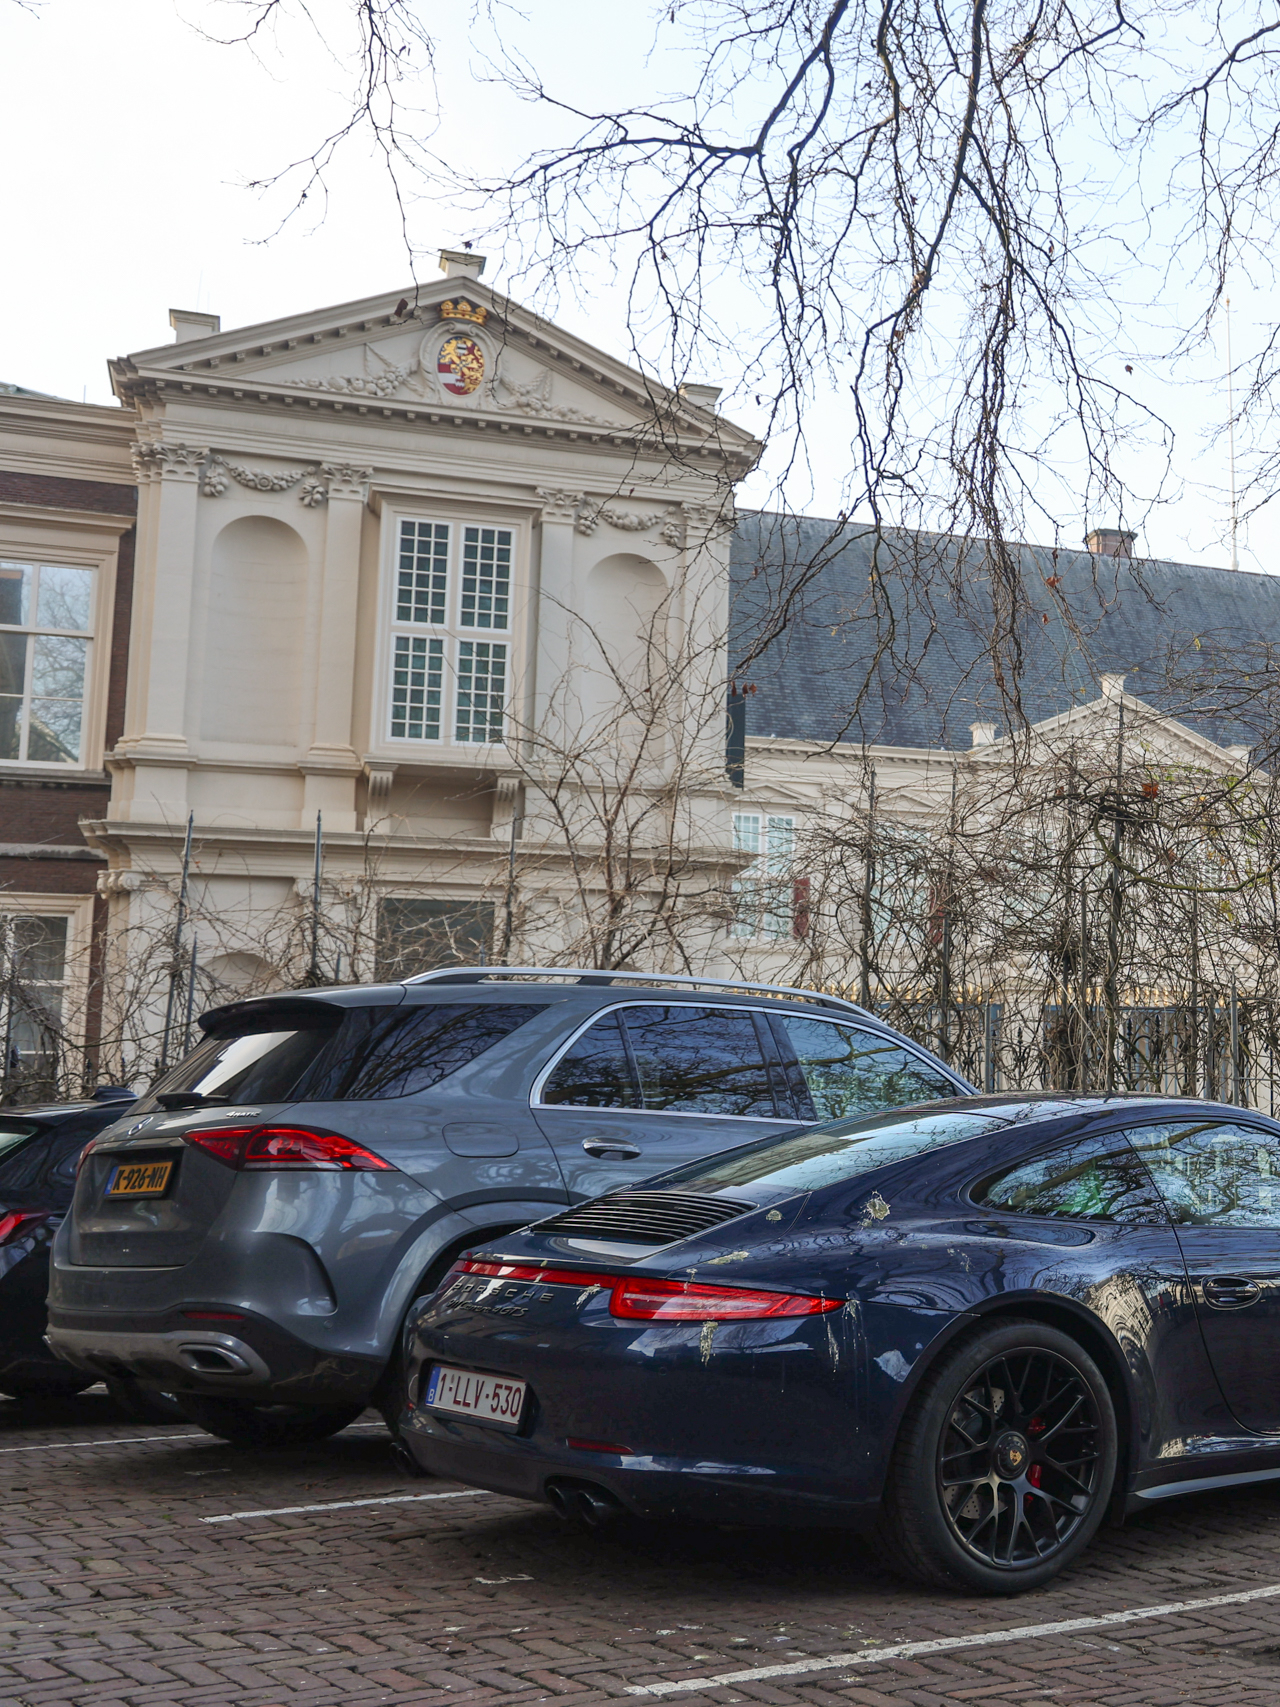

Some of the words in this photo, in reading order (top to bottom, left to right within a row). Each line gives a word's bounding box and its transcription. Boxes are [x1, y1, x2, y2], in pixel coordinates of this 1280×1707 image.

[226, 1110, 260, 1118] 4MATIC
[112, 1166, 168, 1191] K-926-NH
[452, 1283, 555, 1302] PORSCHE
[500, 1306, 529, 1317] GTS
[427, 1389, 435, 1402] B
